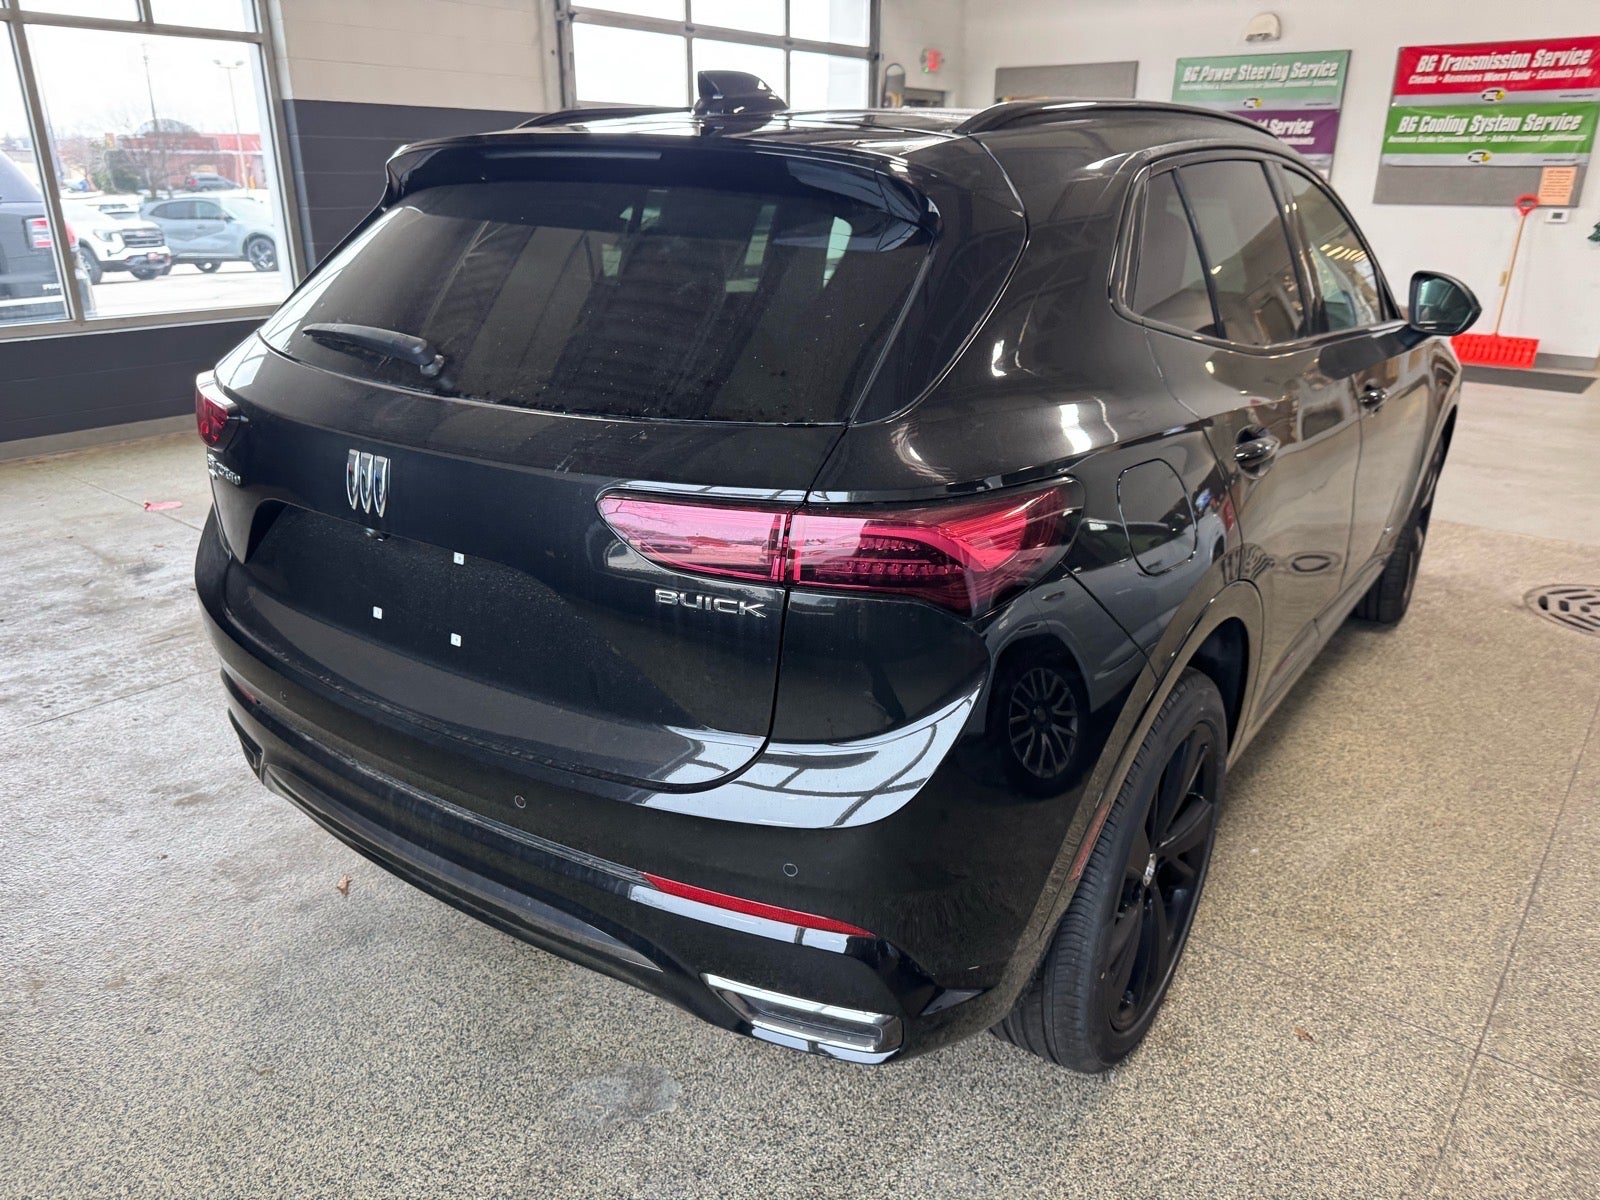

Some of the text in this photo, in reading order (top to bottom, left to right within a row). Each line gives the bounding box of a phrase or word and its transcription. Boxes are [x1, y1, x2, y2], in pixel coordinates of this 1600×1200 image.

[1183, 60, 1339, 82] BG Power Steering Service
[1416, 48, 1593, 73] BG Transmission Service
[1268, 118, 1314, 135] Service
[1397, 113, 1583, 135] BG Cooling System Service
[655, 589, 767, 618] BUICK
